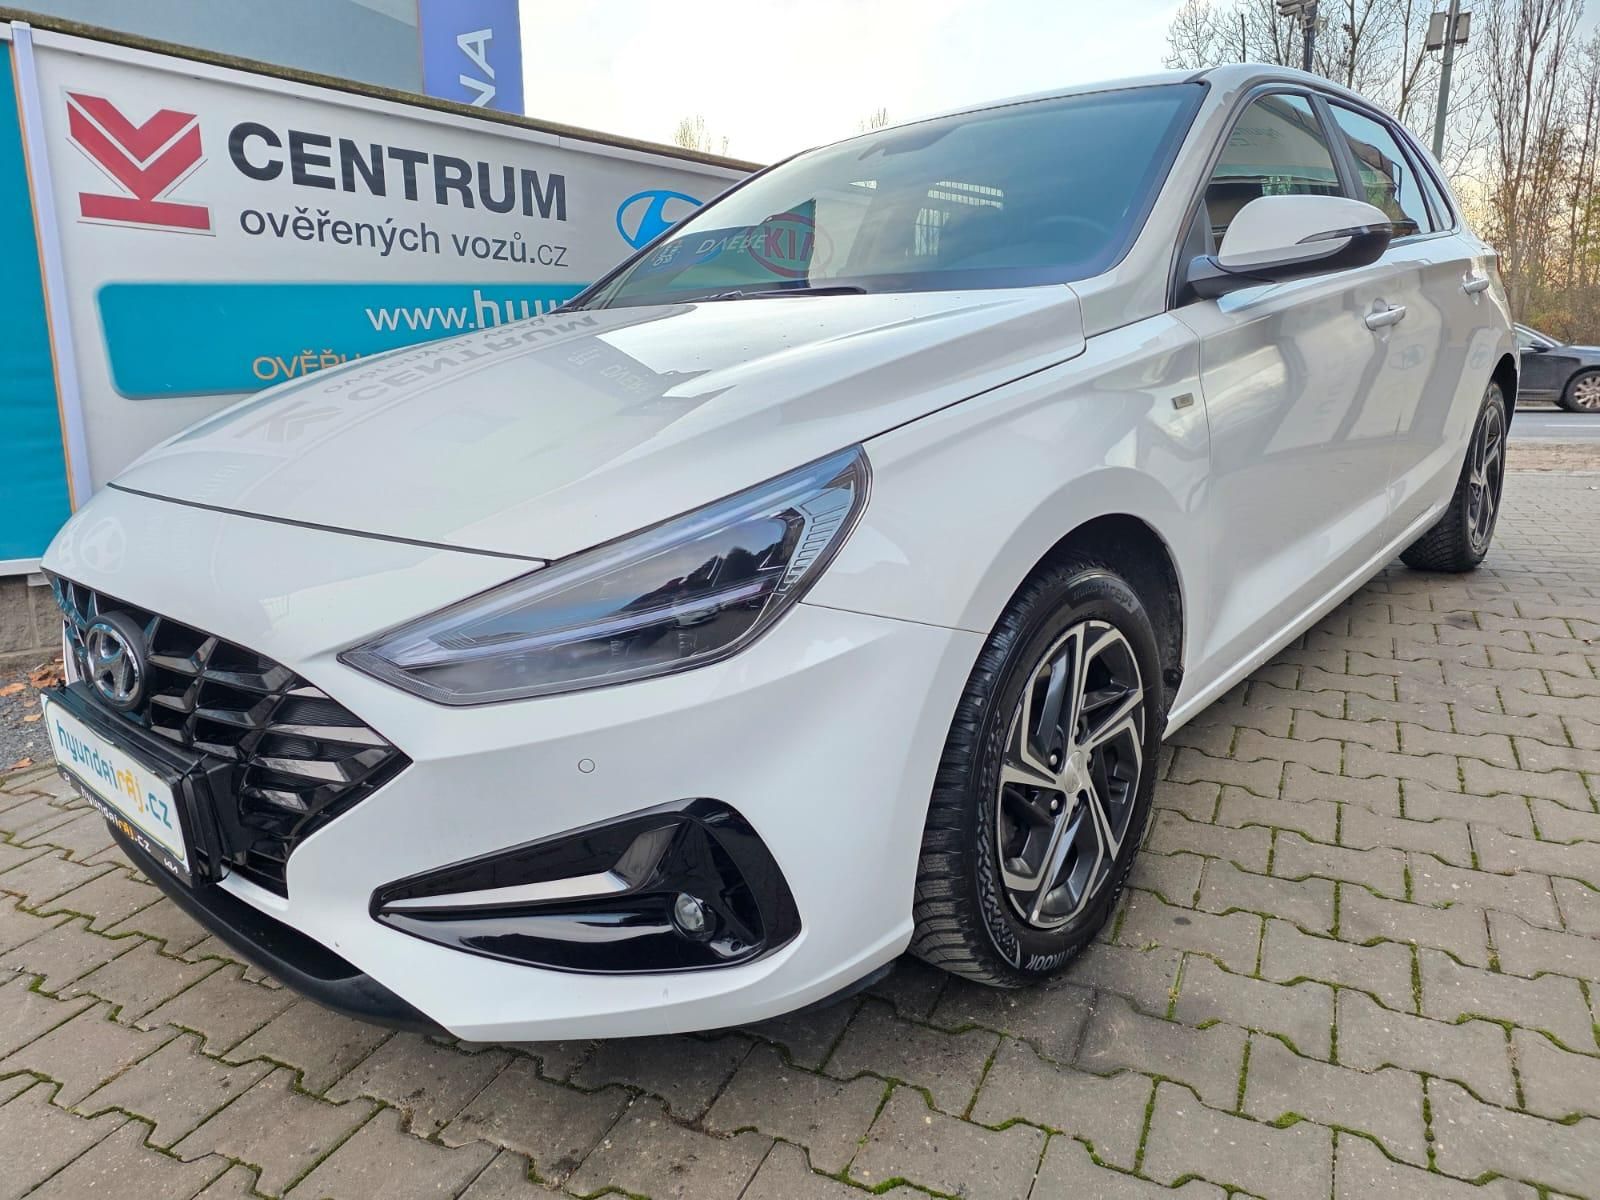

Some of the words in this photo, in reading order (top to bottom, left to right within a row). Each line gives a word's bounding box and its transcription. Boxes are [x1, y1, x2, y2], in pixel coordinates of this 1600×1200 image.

[228, 121, 567, 221] CENTRUM
[240, 206, 440, 256] ověřených
[451, 231, 569, 267] vozů.cz
